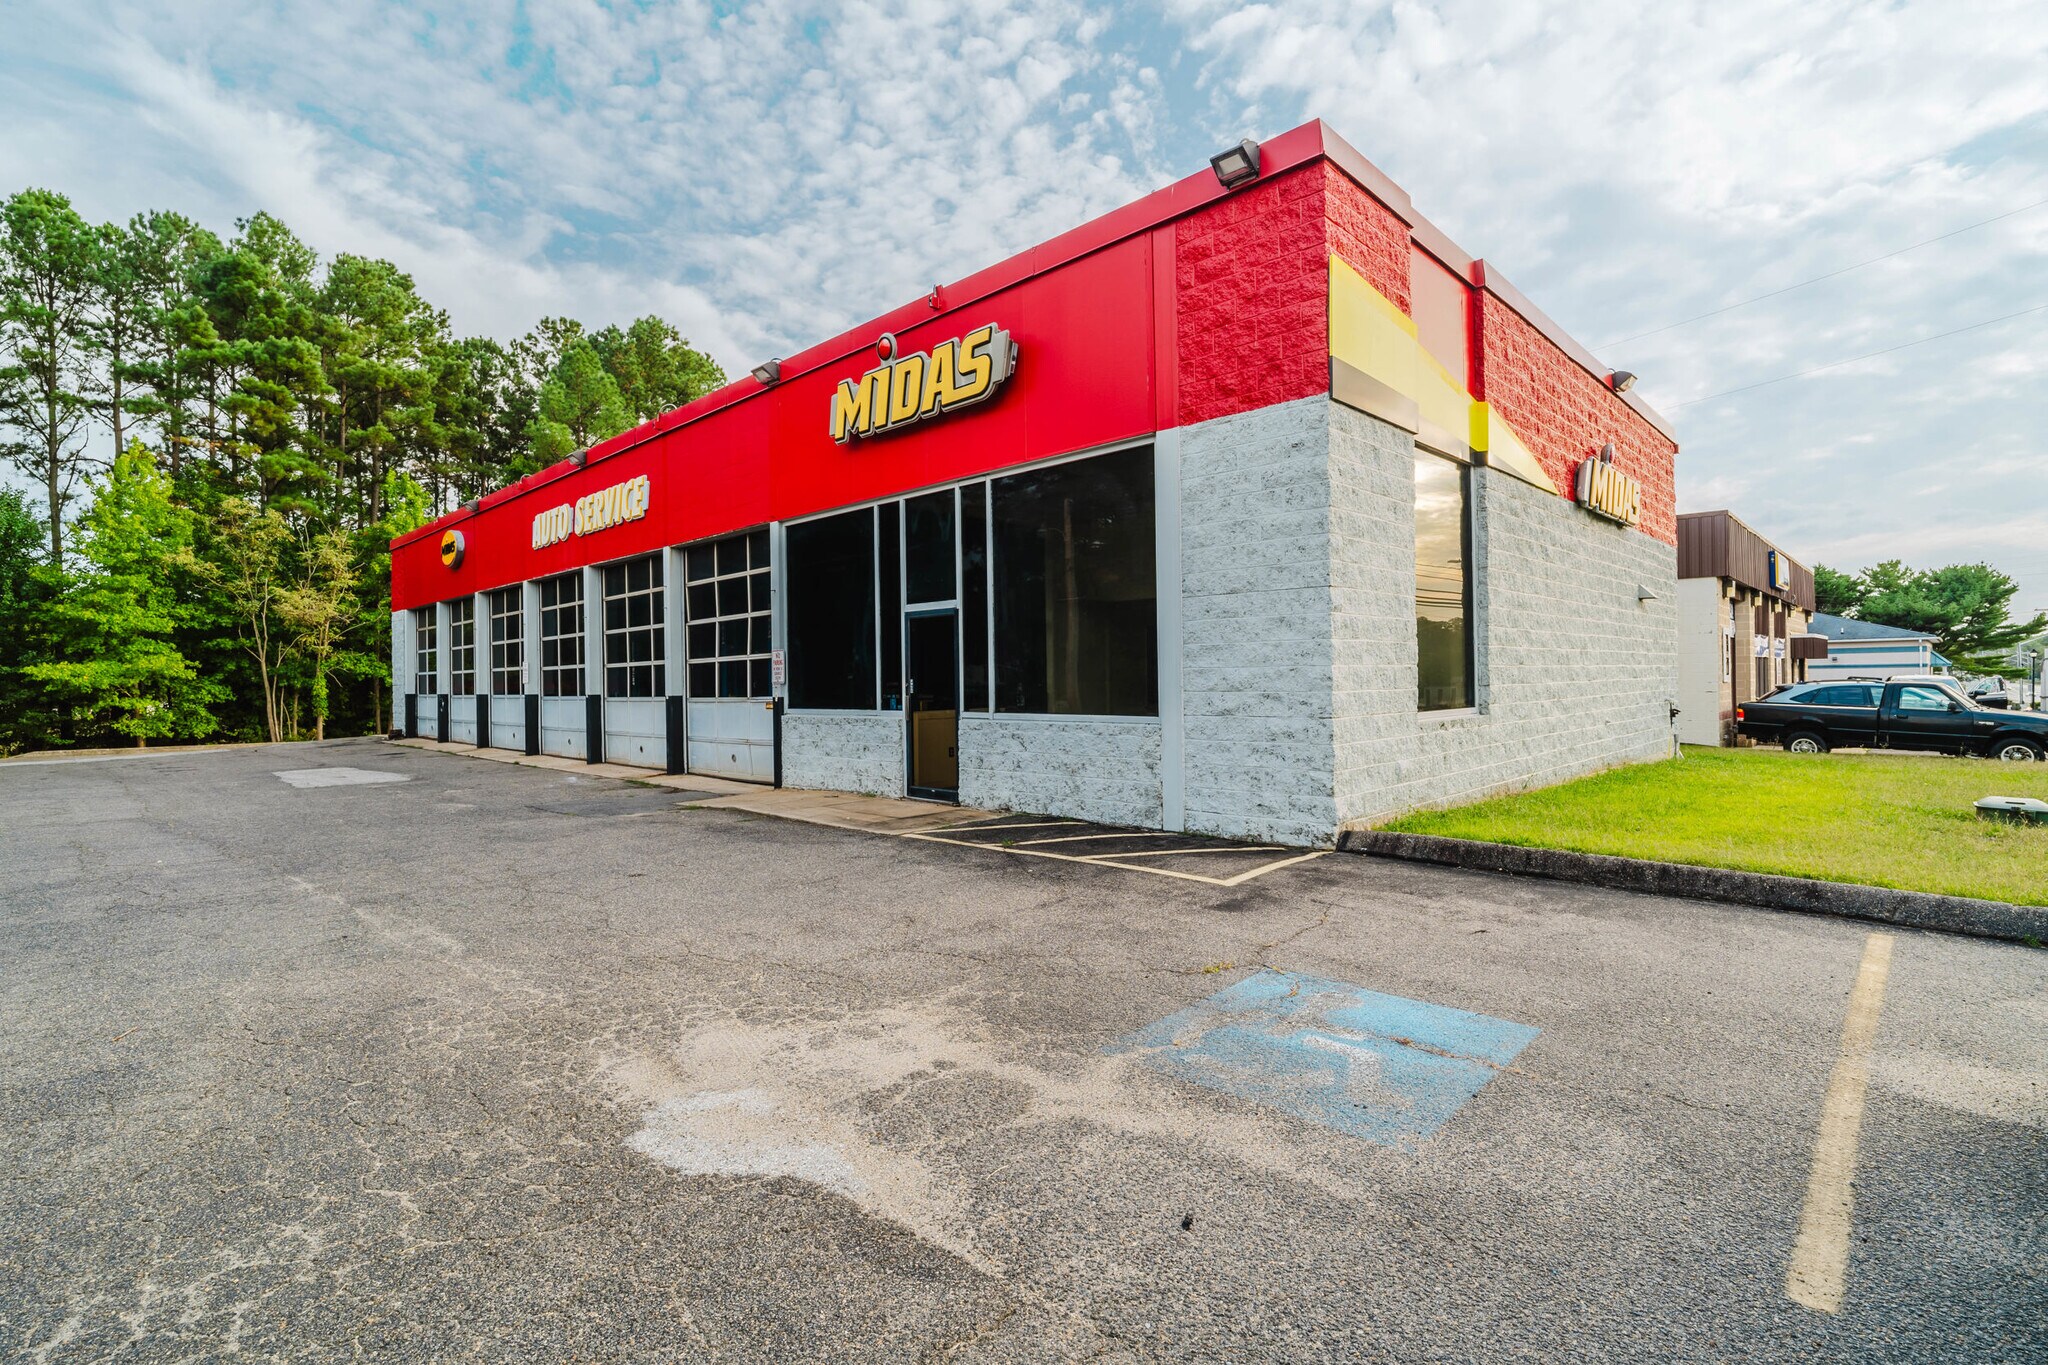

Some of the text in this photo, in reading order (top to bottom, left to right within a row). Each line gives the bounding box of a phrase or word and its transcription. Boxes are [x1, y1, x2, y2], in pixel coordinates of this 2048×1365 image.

[833, 326, 994, 441] MIDAS
[532, 475, 648, 549] AUTO SERVICE
[1589, 455, 1641, 526] MIDAS
